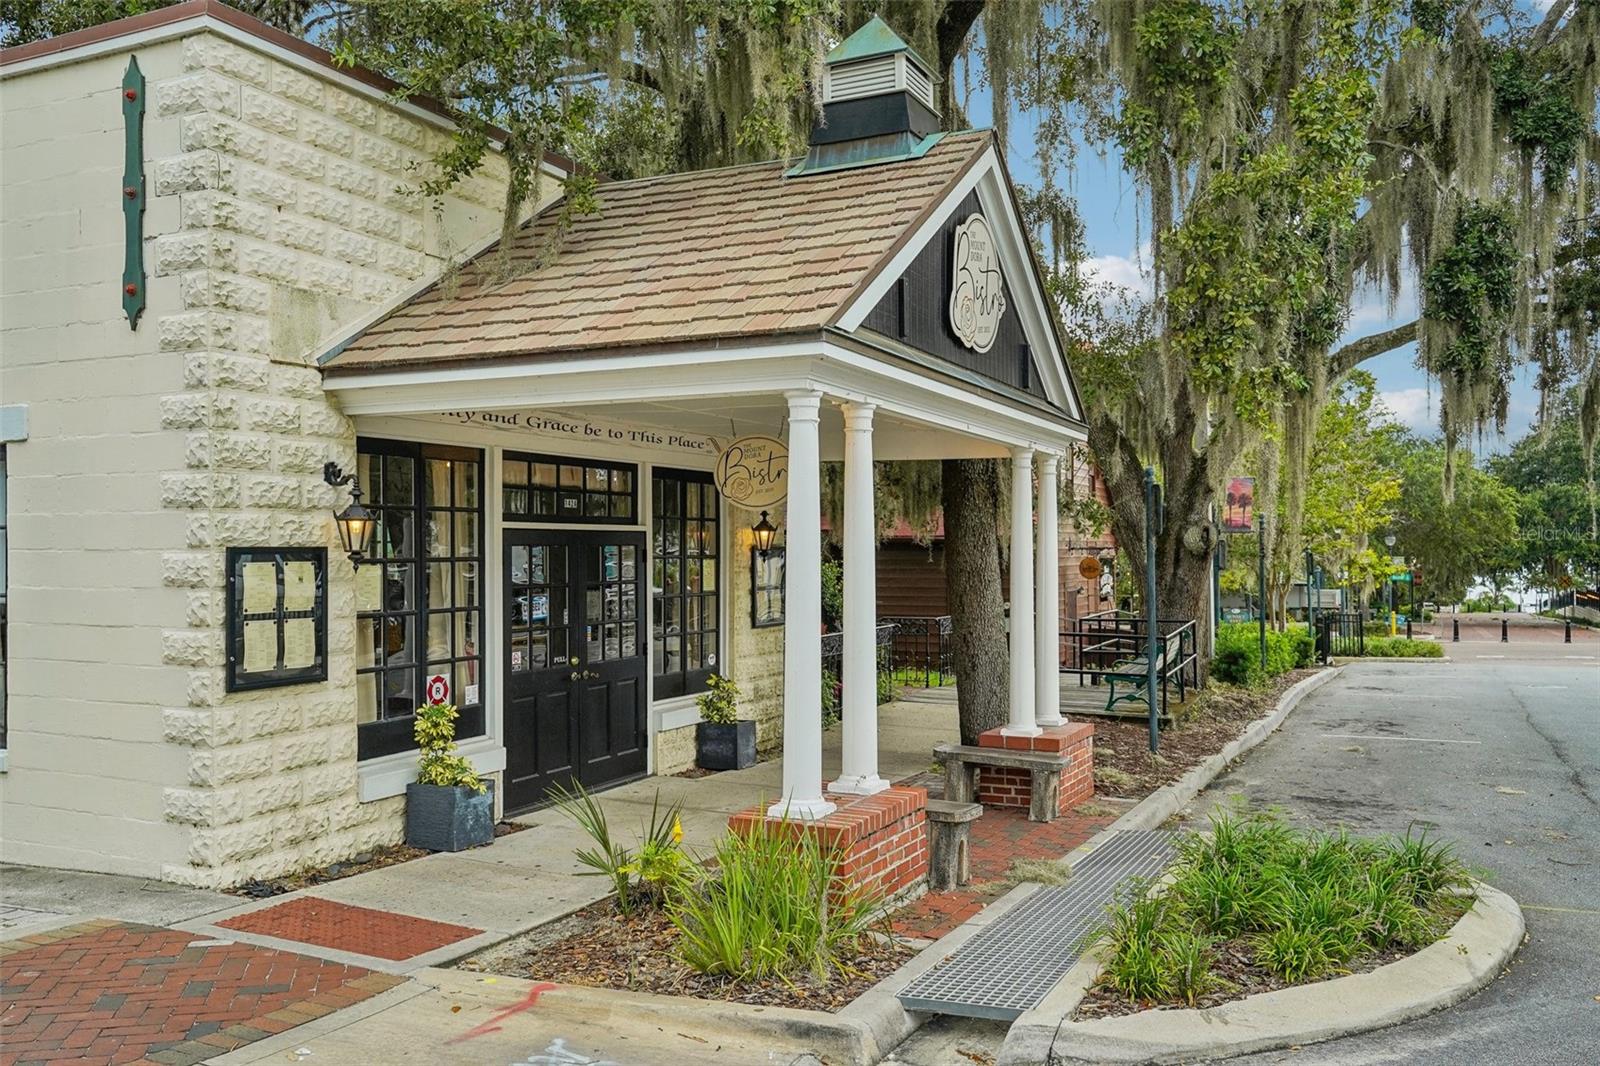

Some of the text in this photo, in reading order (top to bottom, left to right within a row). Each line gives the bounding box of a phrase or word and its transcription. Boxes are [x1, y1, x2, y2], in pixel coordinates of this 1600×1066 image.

[482, 413, 520, 426] and
[526, 416, 578, 434] Grace
[584, 423, 602, 437] be
[608, 428, 623, 439] to
[627, 430, 663, 444] This
[668, 435, 705, 449] Place
[721, 446, 788, 498] Bistr
[435, 686, 441, 696] R
